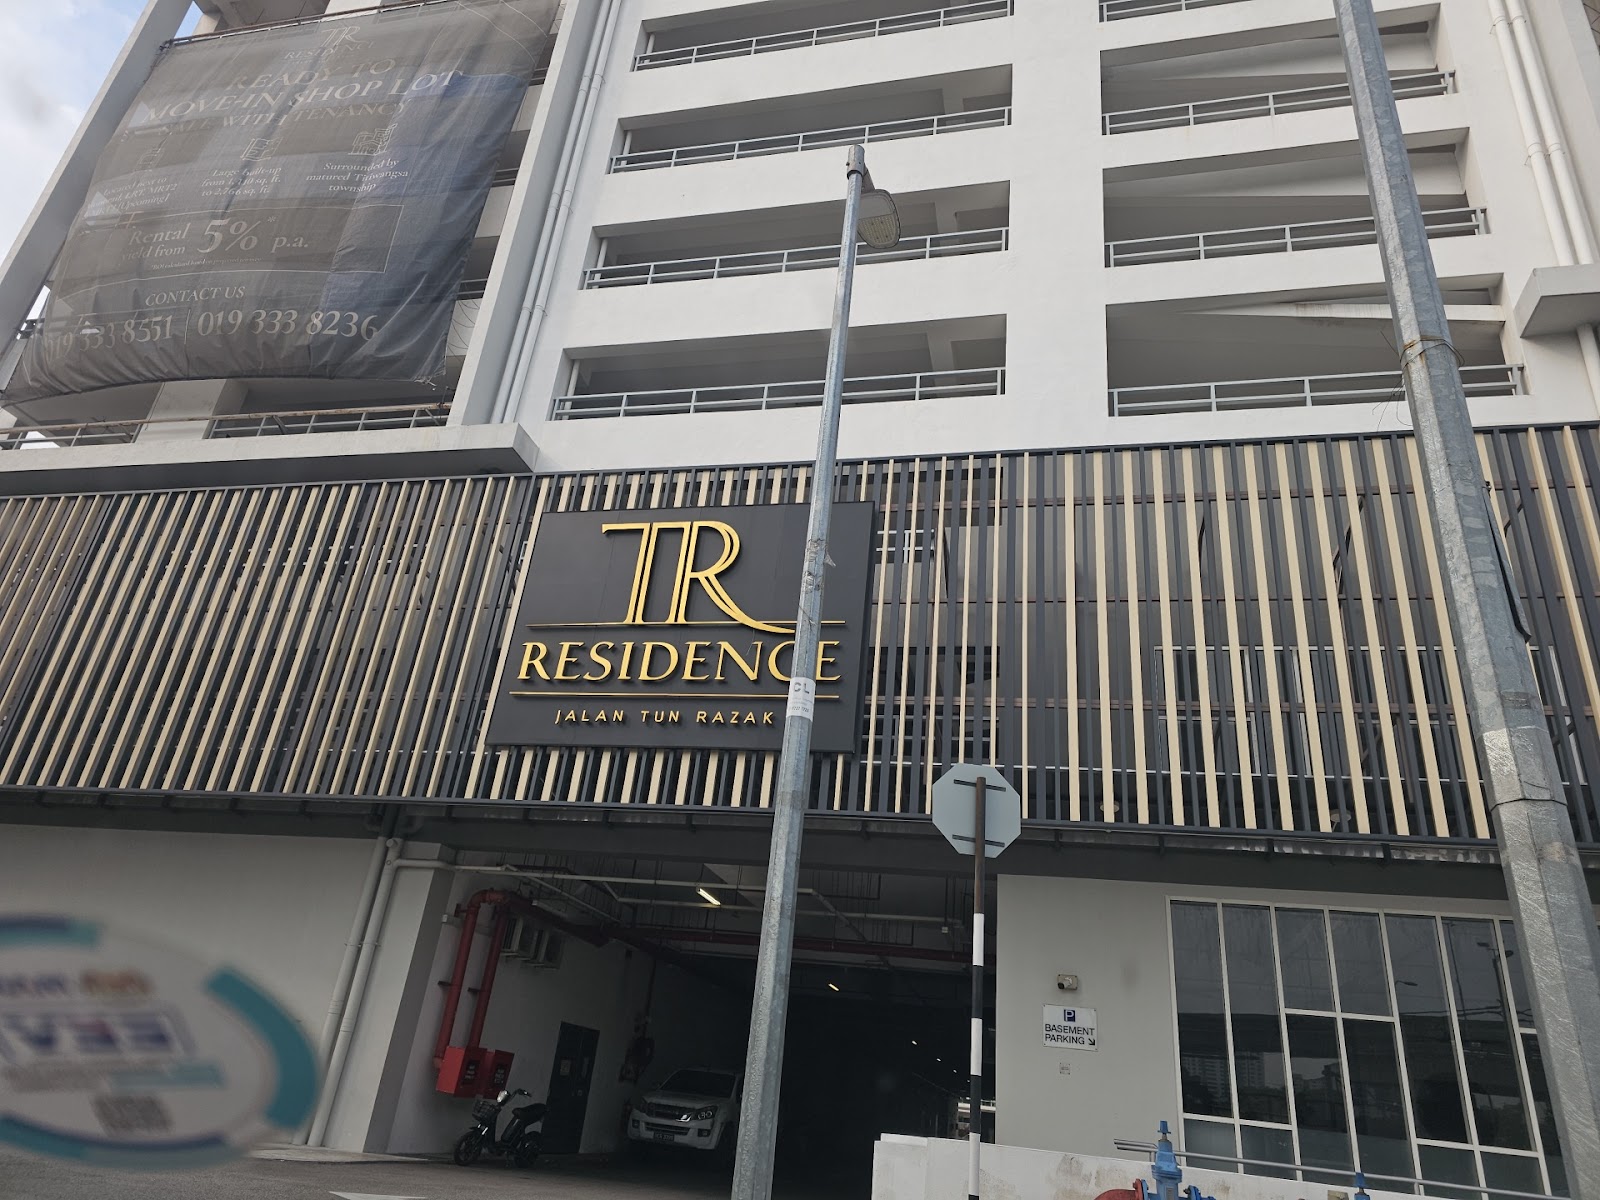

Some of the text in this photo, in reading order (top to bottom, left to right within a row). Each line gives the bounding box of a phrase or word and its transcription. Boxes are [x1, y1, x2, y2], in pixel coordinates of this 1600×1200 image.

[225, 67, 342, 91] READY
[352, 58, 396, 79] TO
[145, 70, 465, 122] MOVE-IN SHOP LOT
[222, 113, 289, 129] WITH
[294, 99, 412, 122] TENANCY
[213, 168, 240, 178] Large
[324, 157, 400, 172] Surrounded by
[202, 179, 225, 187] from
[305, 170, 409, 181] matured Titiwangsa
[329, 182, 377, 192] township
[129, 223, 192, 246] Rental
[270, 234, 309, 254] p.a.
[122, 244, 186, 262] yield from
[145, 286, 246, 306] CONTACT US
[121, 315, 173, 345] 8551
[197, 309, 243, 336] 019
[251, 309, 298, 335] 333
[306, 310, 378, 341] 8236
[601, 520, 797, 634] TR
[517, 640, 842, 682] RESIDENCE
[554, 709, 774, 725] JALAN TUN RAZAK
[1044, 1023, 1095, 1036] BASEMENT
[1044, 1033, 1085, 1045] PARKING
